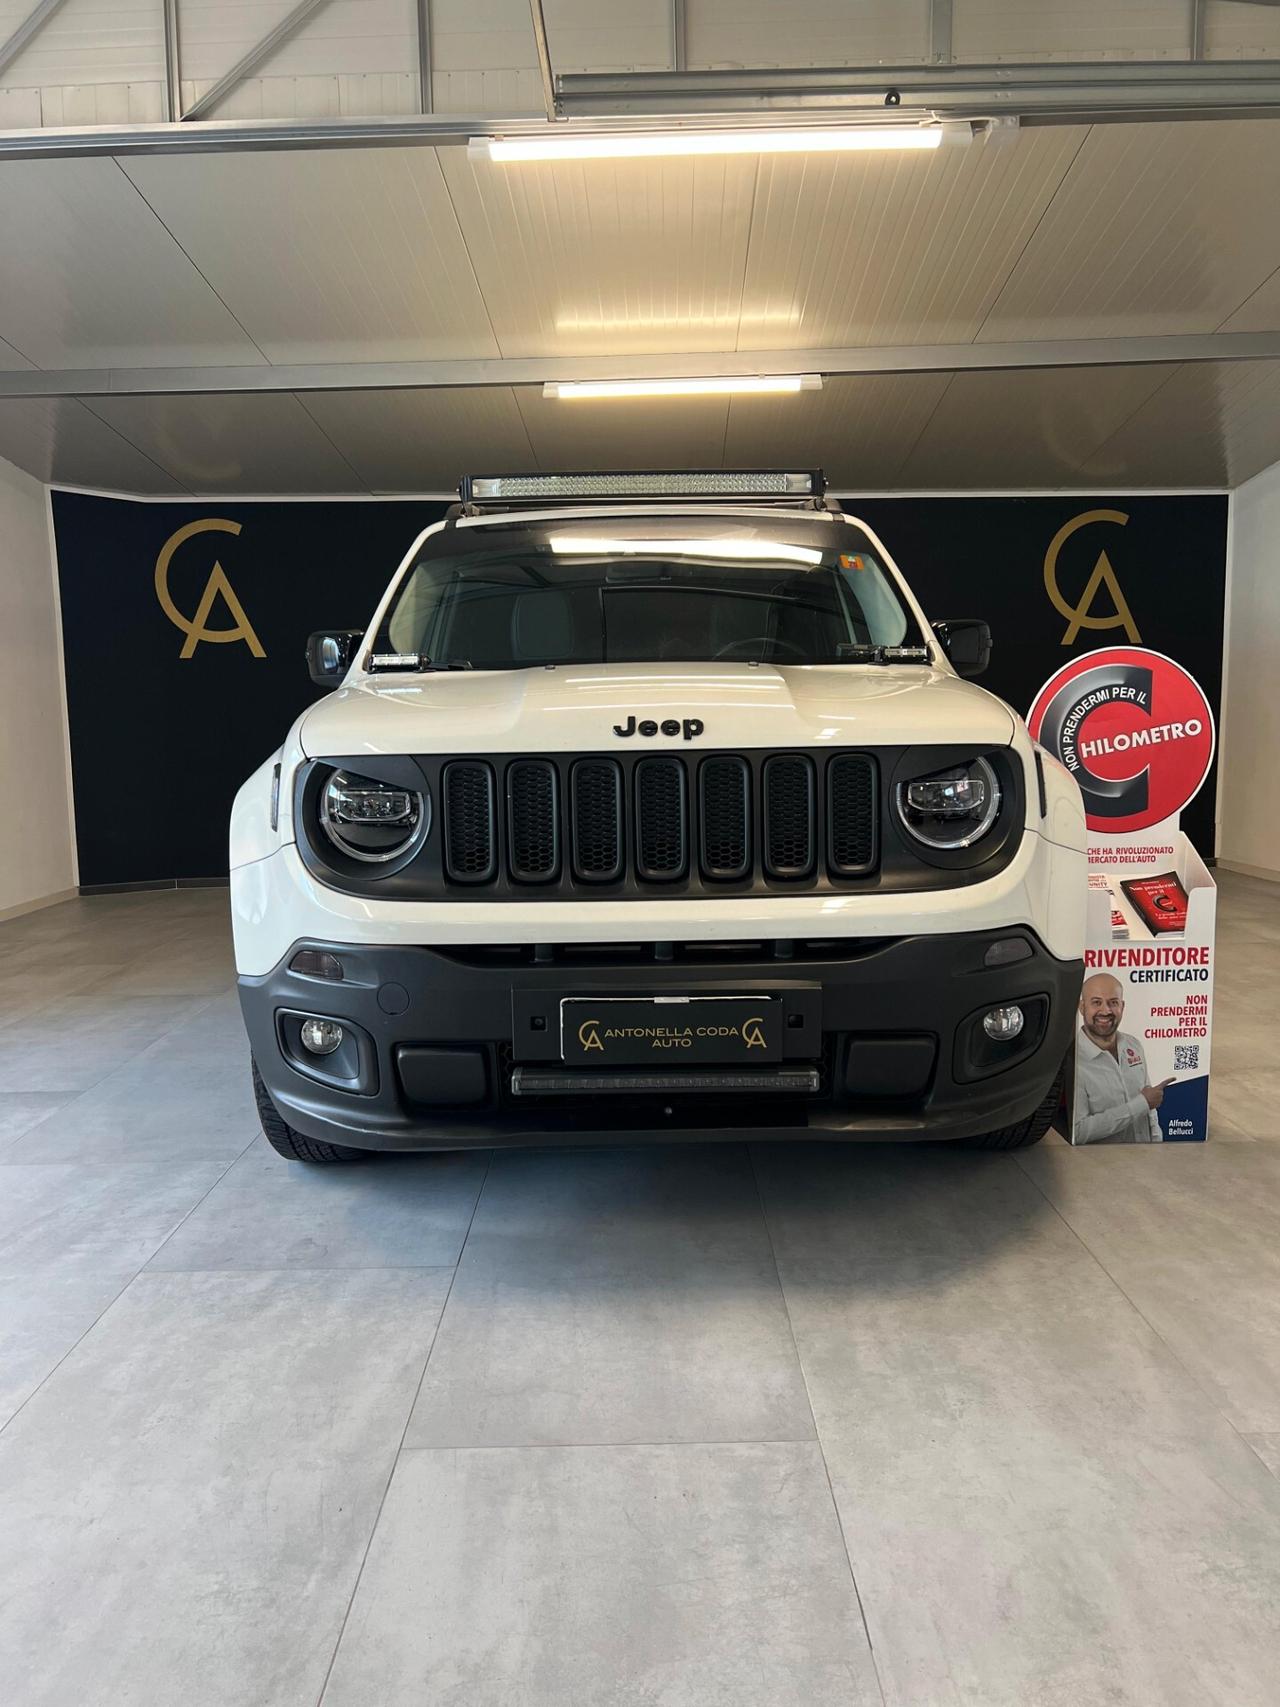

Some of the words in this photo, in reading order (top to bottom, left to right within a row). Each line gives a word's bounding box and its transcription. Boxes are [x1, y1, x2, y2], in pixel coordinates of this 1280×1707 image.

[1112, 687, 1135, 699] PER
[1137, 691, 1146, 705] IL
[1063, 689, 1110, 743] PRENDERMI
[613, 716, 704, 740] Jeep
[1080, 718, 1202, 758] HILOMETRO
[1063, 746, 1080, 772] NON
[1087, 847, 1101, 856] CHE
[1102, 847, 1113, 855] HA
[1116, 846, 1174, 855] RIVOLUZIONATO
[1119, 855, 1156, 863] DELL'AUTO
[1084, 947, 1209, 967] RIVENDITORE
[1130, 968, 1209, 983] CERTIFICATO
[1186, 995, 1208, 1005] NON
[1150, 1006, 1208, 1017] PRENDERMI
[1179, 1017, 1198, 1027] PER
[1199, 1017, 1208, 1027] IL
[604, 1027, 694, 1038] ANTONELLA
[696, 1026, 739, 1037] CODA
[1144, 1027, 1207, 1039] CHILOMETRO
[652, 1039, 692, 1048] AUTO
[1168, 1119, 1193, 1128] Alfredo
[1168, 1127, 1194, 1136] Bellucci
